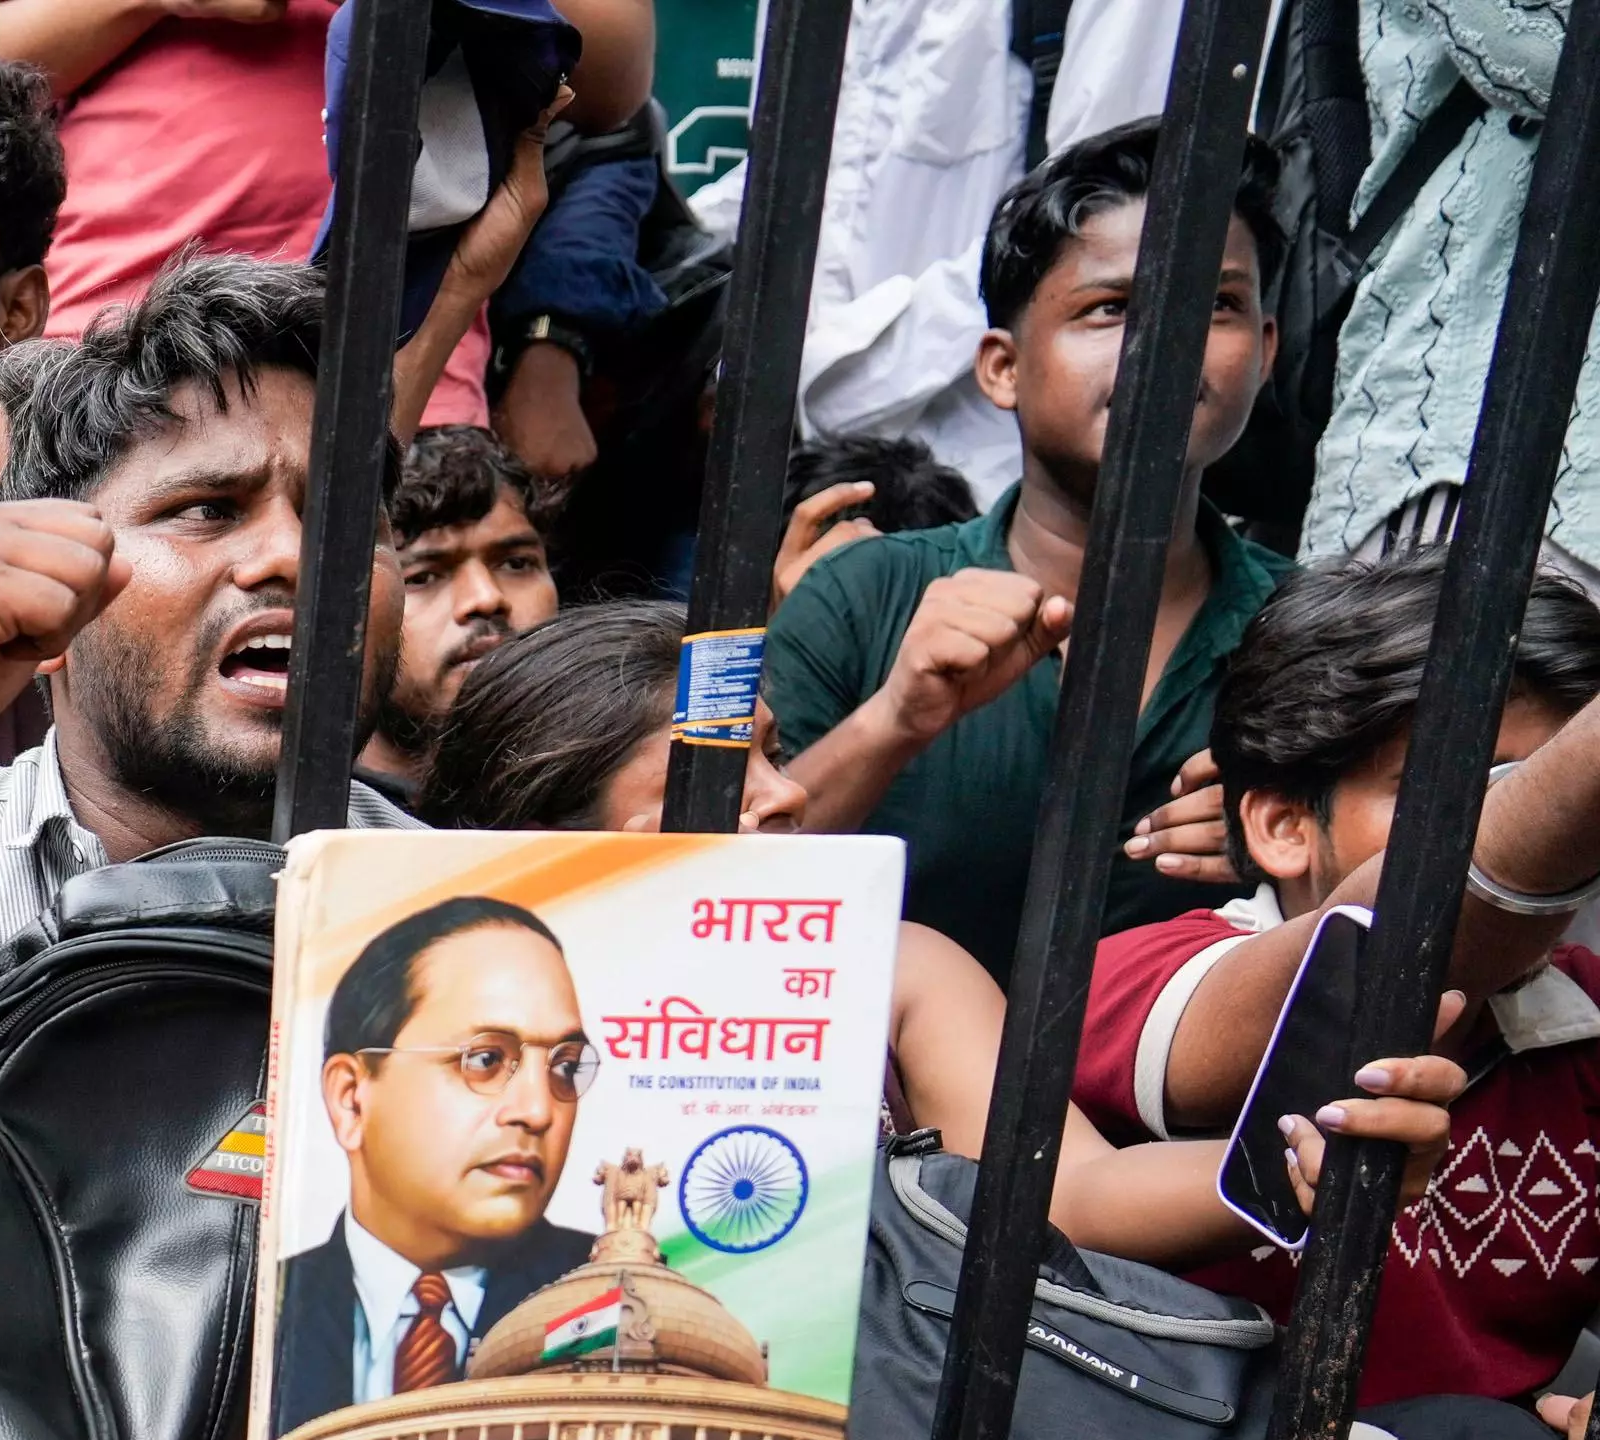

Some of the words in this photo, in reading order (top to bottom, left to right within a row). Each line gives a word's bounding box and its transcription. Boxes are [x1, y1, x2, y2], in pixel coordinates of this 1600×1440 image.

[691, 898, 843, 943] भारत
[782, 967, 837, 999] का
[601, 995, 830, 1062] संविधान
[629, 1074, 653, 1089] THE
[658, 1075, 757, 1090] CONSTITUTION
[762, 1076, 779, 1090] OF
[784, 1076, 821, 1091] INDIA
[1028, 1322, 1124, 1378] AMILIANT
